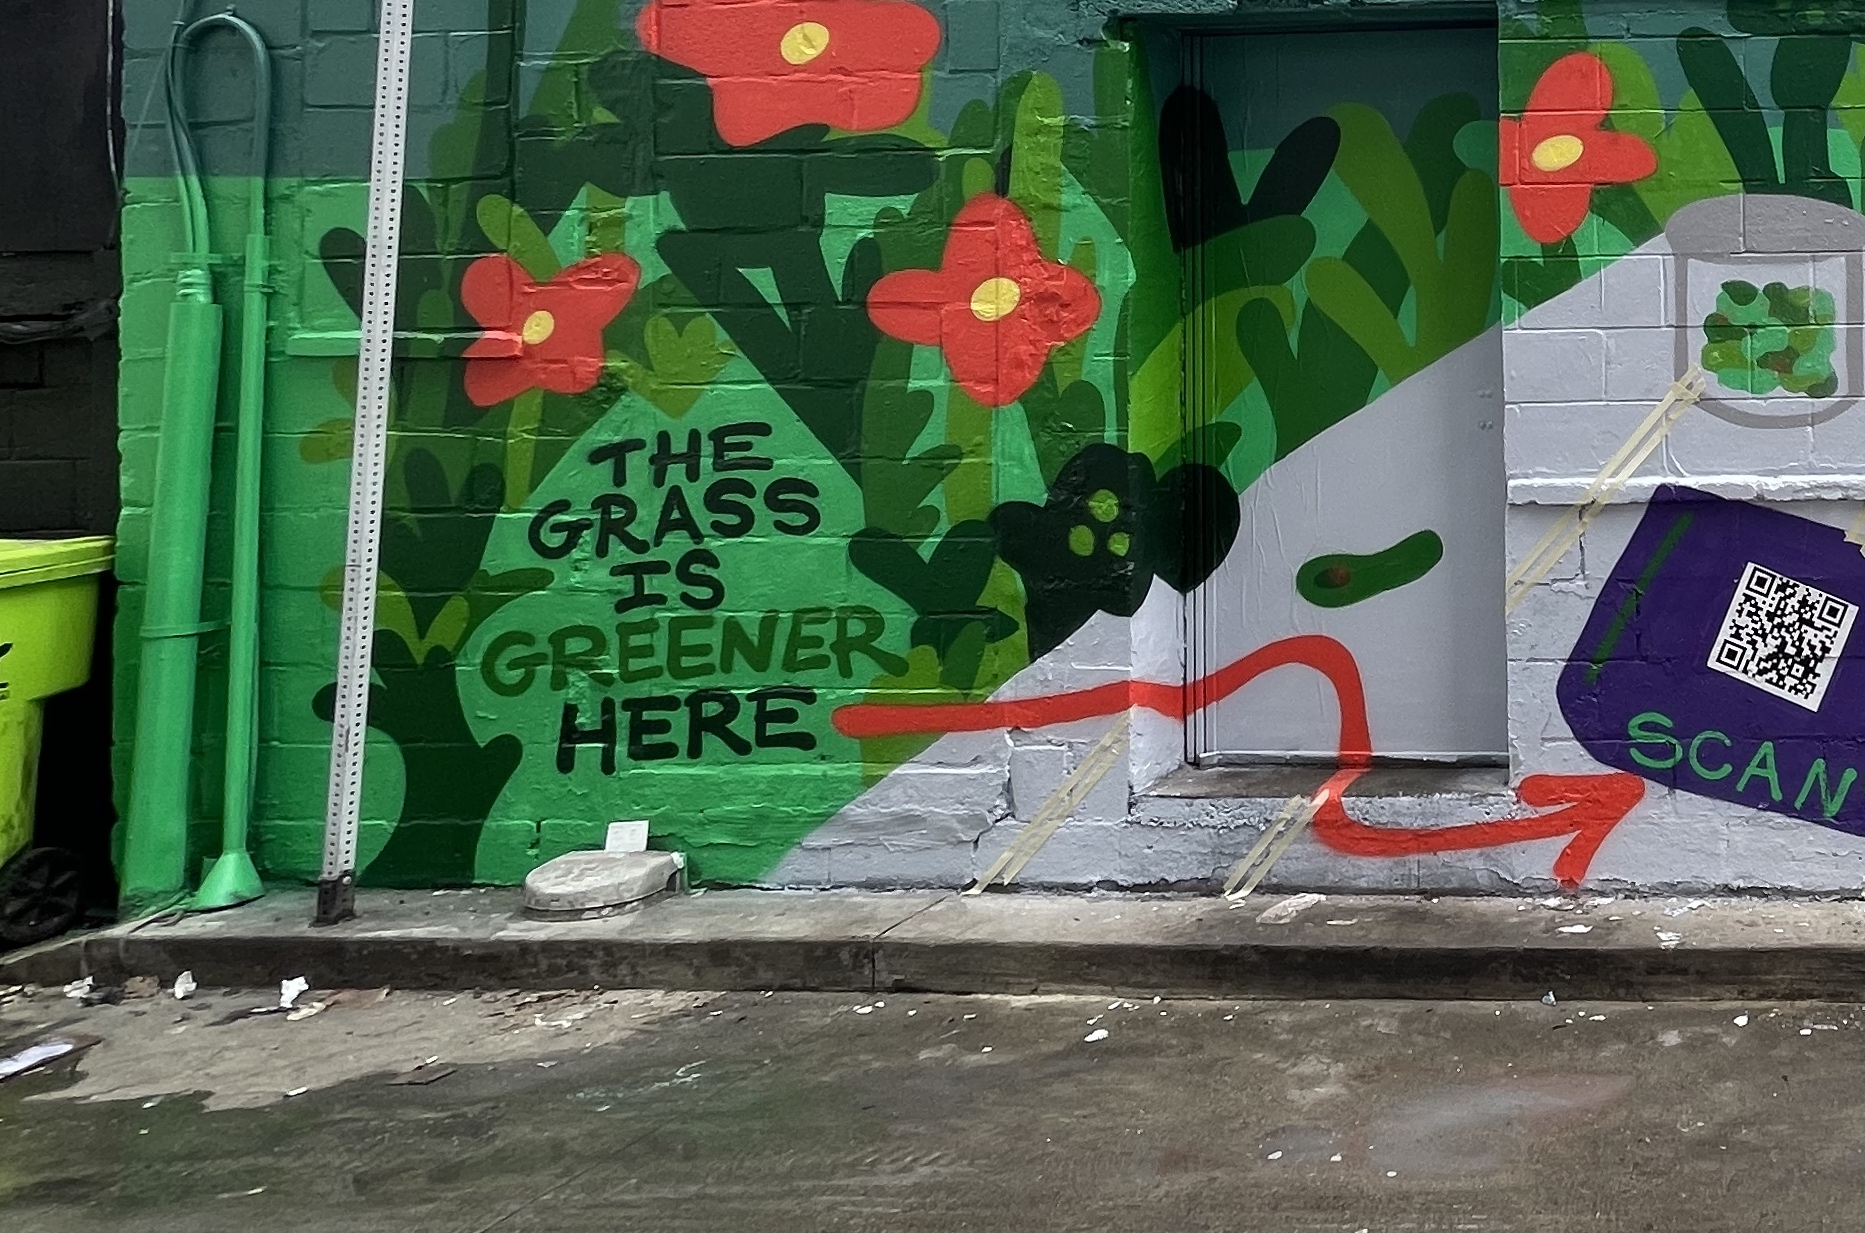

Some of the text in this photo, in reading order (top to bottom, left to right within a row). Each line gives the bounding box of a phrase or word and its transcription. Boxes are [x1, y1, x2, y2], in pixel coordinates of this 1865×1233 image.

[588, 421, 774, 490] THE
[527, 477, 821, 560] GRASS
[609, 549, 725, 614] IS
[480, 605, 910, 698] GREENER
[556, 687, 818, 776] HERE
[1627, 711, 1859, 819] SCAN
